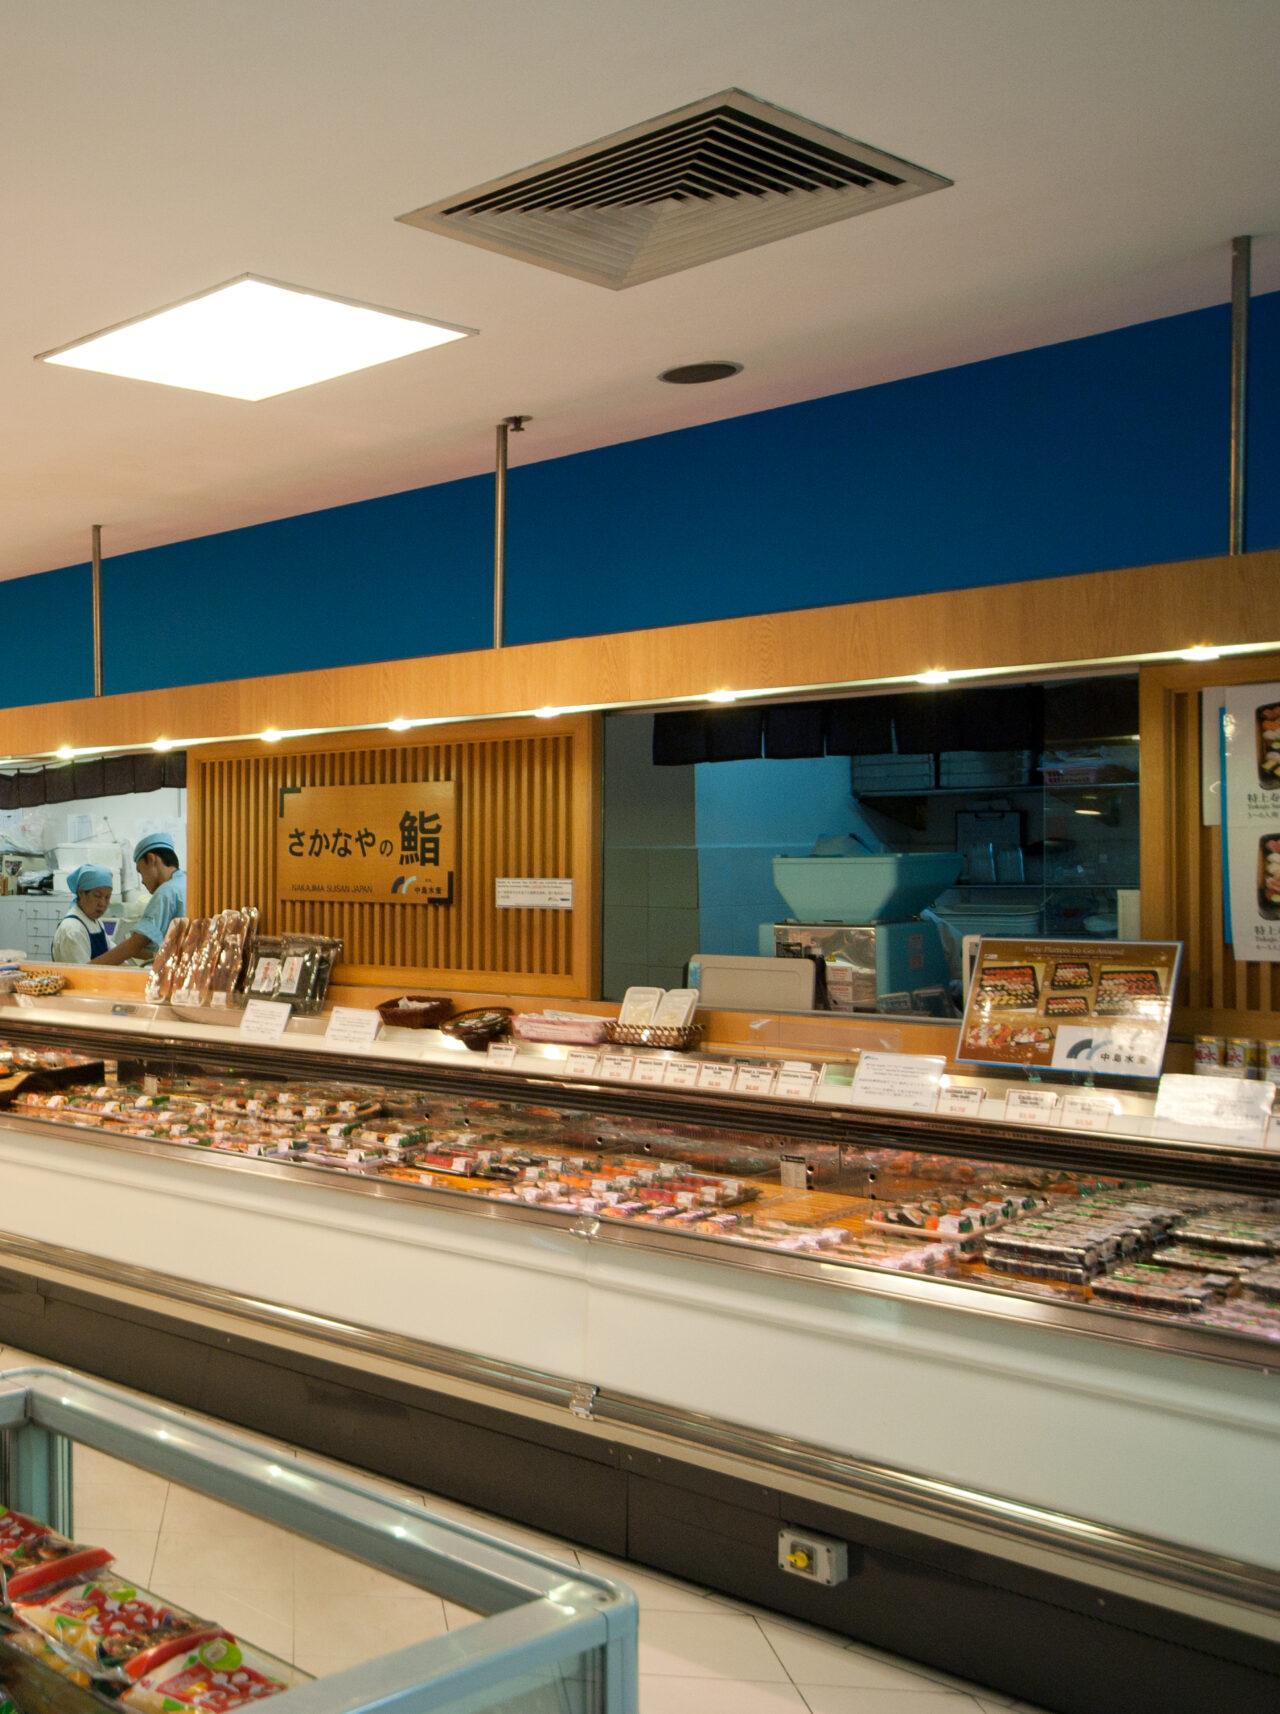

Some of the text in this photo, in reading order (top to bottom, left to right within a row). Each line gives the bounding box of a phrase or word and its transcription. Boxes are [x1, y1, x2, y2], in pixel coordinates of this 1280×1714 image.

[288, 810, 443, 867] さかなやの鮨
